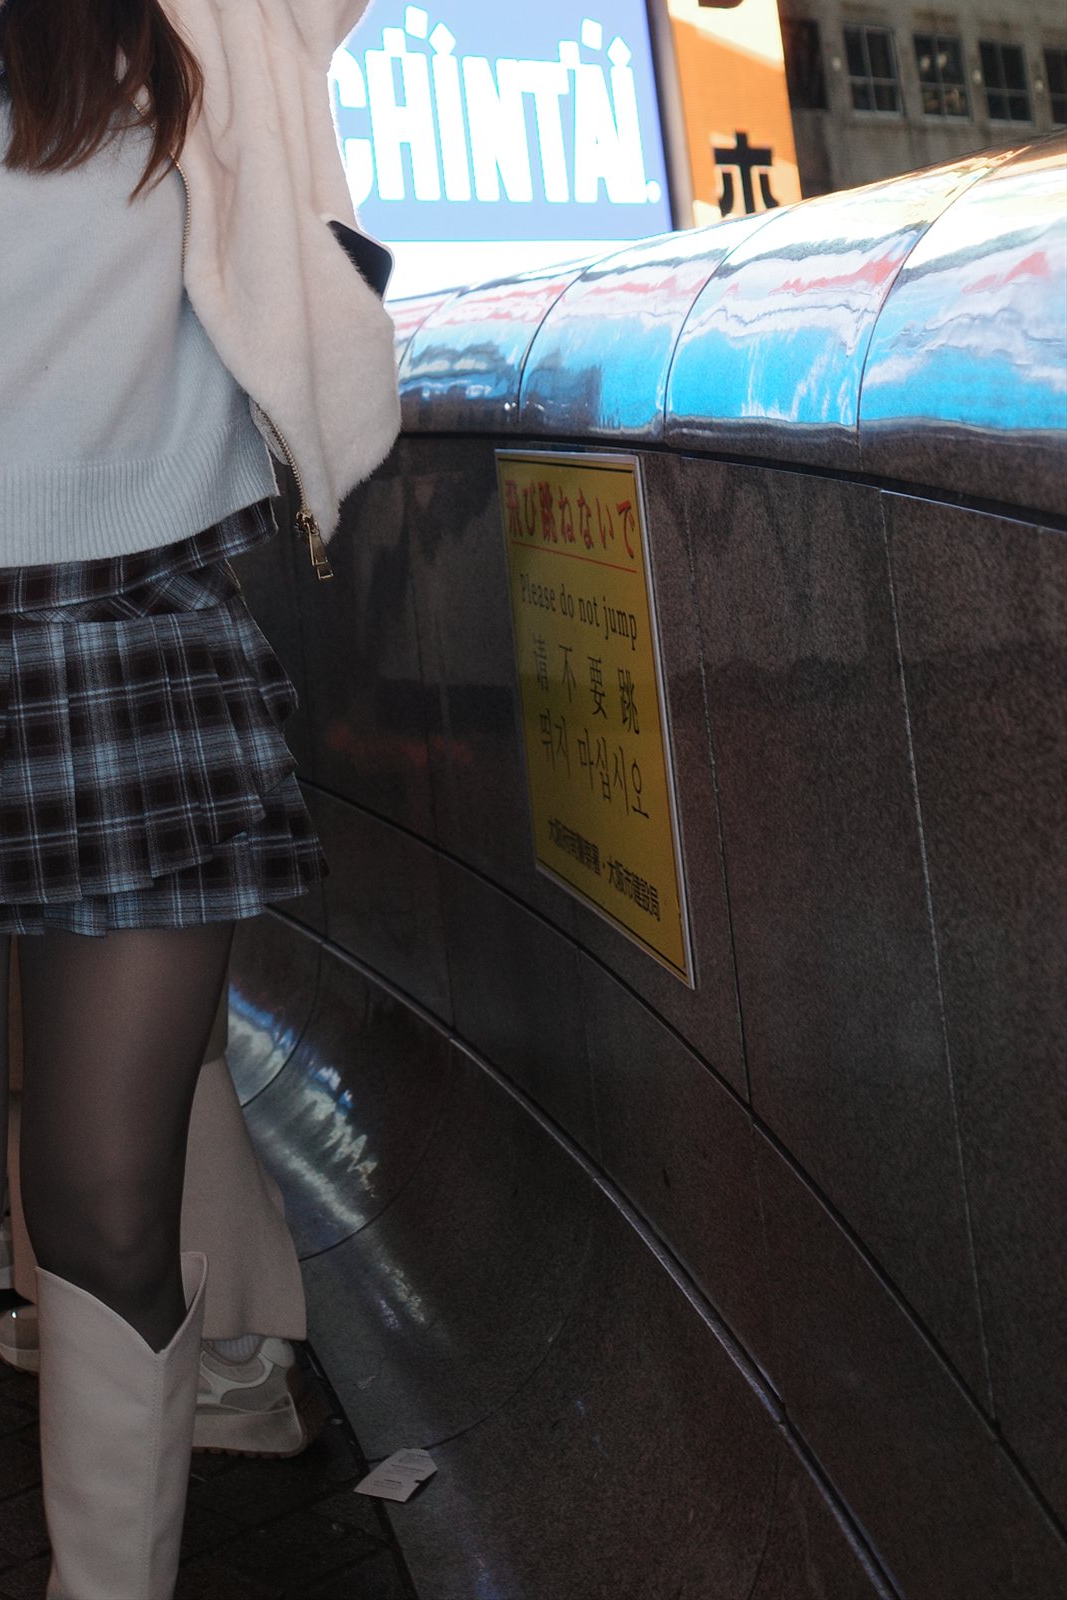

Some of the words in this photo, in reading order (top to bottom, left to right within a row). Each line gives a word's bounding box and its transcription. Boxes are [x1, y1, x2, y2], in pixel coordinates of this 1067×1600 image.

[504, 480, 635, 559] 飛び跳ねないで
[520, 573, 556, 613] Please
[560, 583, 575, 618] do
[578, 596, 600, 627] not
[603, 596, 638, 650] jump
[577, 728, 650, 820] 마십시오
